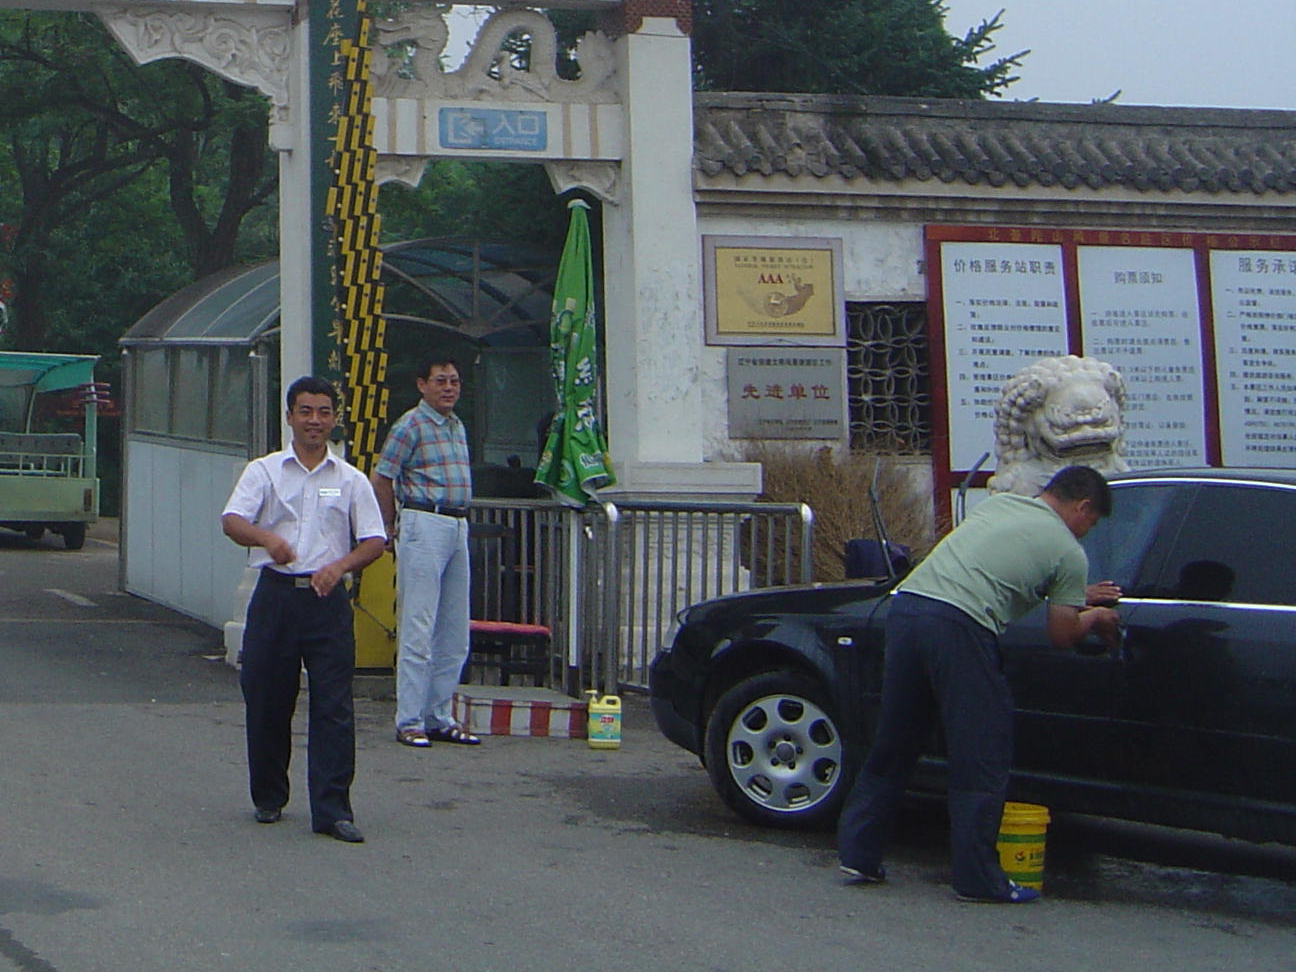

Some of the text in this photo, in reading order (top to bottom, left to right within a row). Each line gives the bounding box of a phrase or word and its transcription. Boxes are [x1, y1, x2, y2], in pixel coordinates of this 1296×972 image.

[493, 114, 539, 135] 入口
[494, 136, 537, 145] ENTRANCE
[953, 258, 1056, 275] 价格服务站职责
[758, 273, 784, 284] AAA
[1113, 270, 1163, 285] 购票须知
[741, 383, 831, 400] 先进单位
